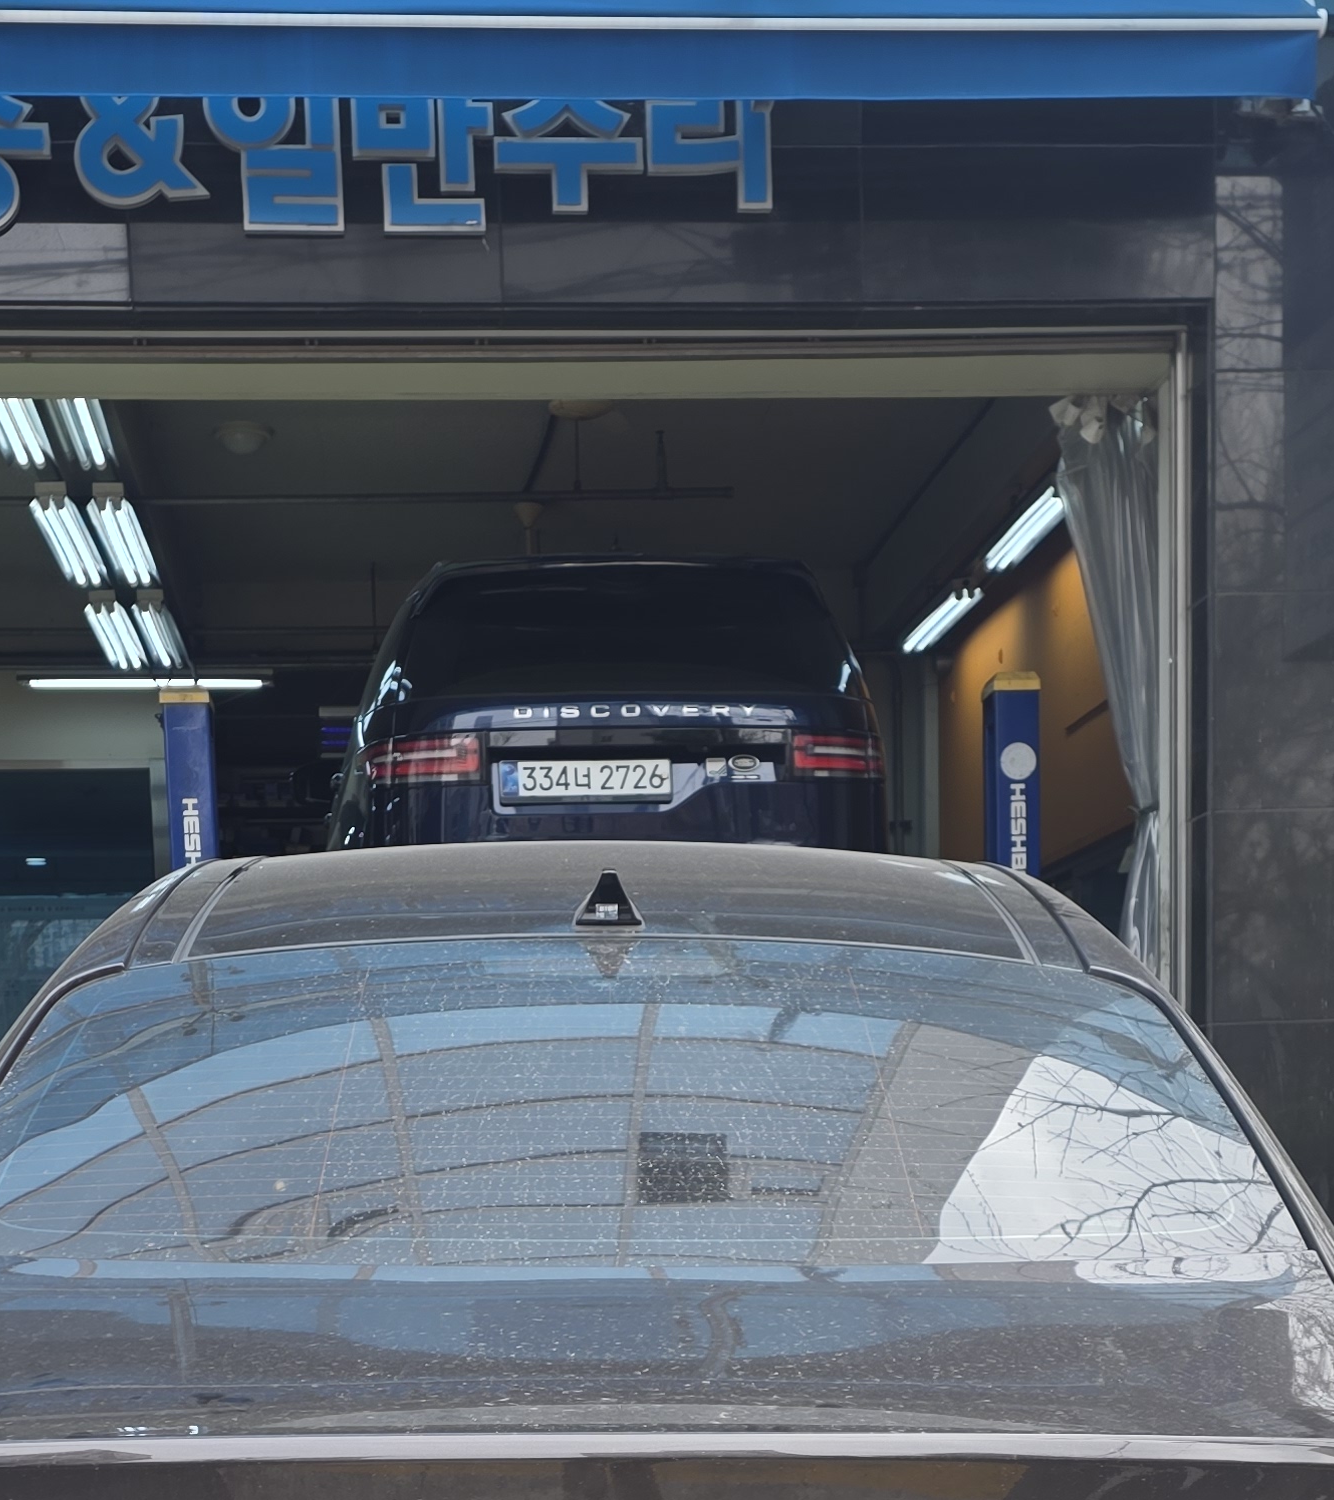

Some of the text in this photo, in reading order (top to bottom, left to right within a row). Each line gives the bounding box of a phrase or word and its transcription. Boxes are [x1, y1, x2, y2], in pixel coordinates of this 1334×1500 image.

[513, 704, 755, 719] DISCOVERY
[522, 764, 665, 791] 334너 2726
[1010, 782, 1028, 872] HESHB
